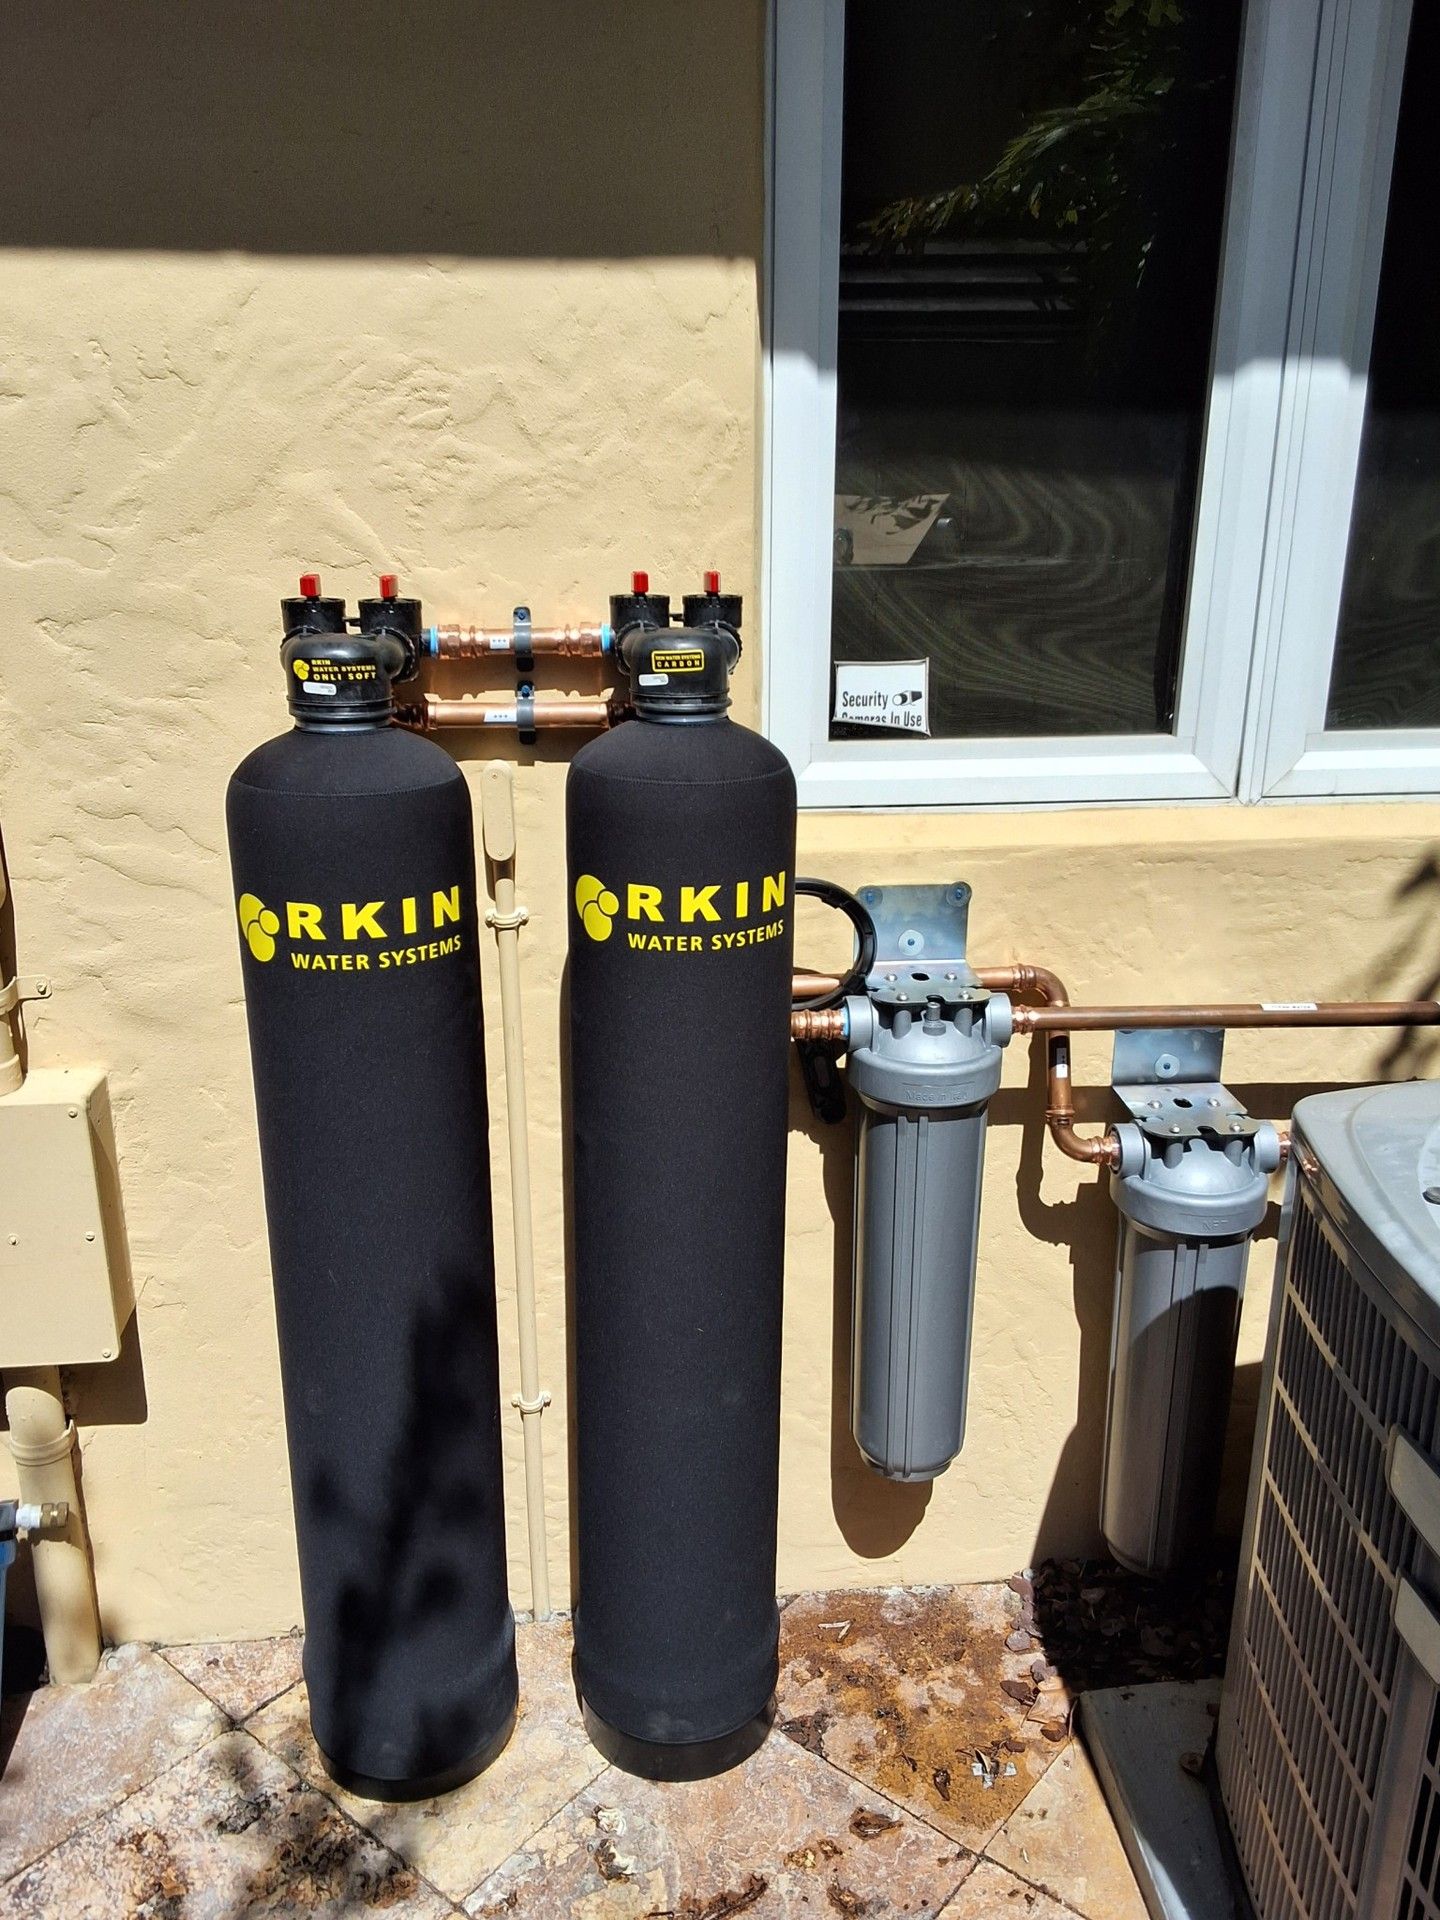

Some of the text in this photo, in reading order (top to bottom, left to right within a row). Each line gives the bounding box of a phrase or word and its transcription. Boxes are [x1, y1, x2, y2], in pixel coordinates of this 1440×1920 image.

[313, 672, 376, 681] ONLI SOFT
[656, 660, 700, 668] CARBON
[842, 690, 889, 710] Security
[890, 711, 901, 725] In
[903, 710, 922, 727] Use
[627, 870, 786, 923] RKIN
[285, 885, 461, 940] RKIN
[627, 919, 784, 952] WATER SYSTEMS
[290, 934, 462, 971] WATER SYSTEMS
